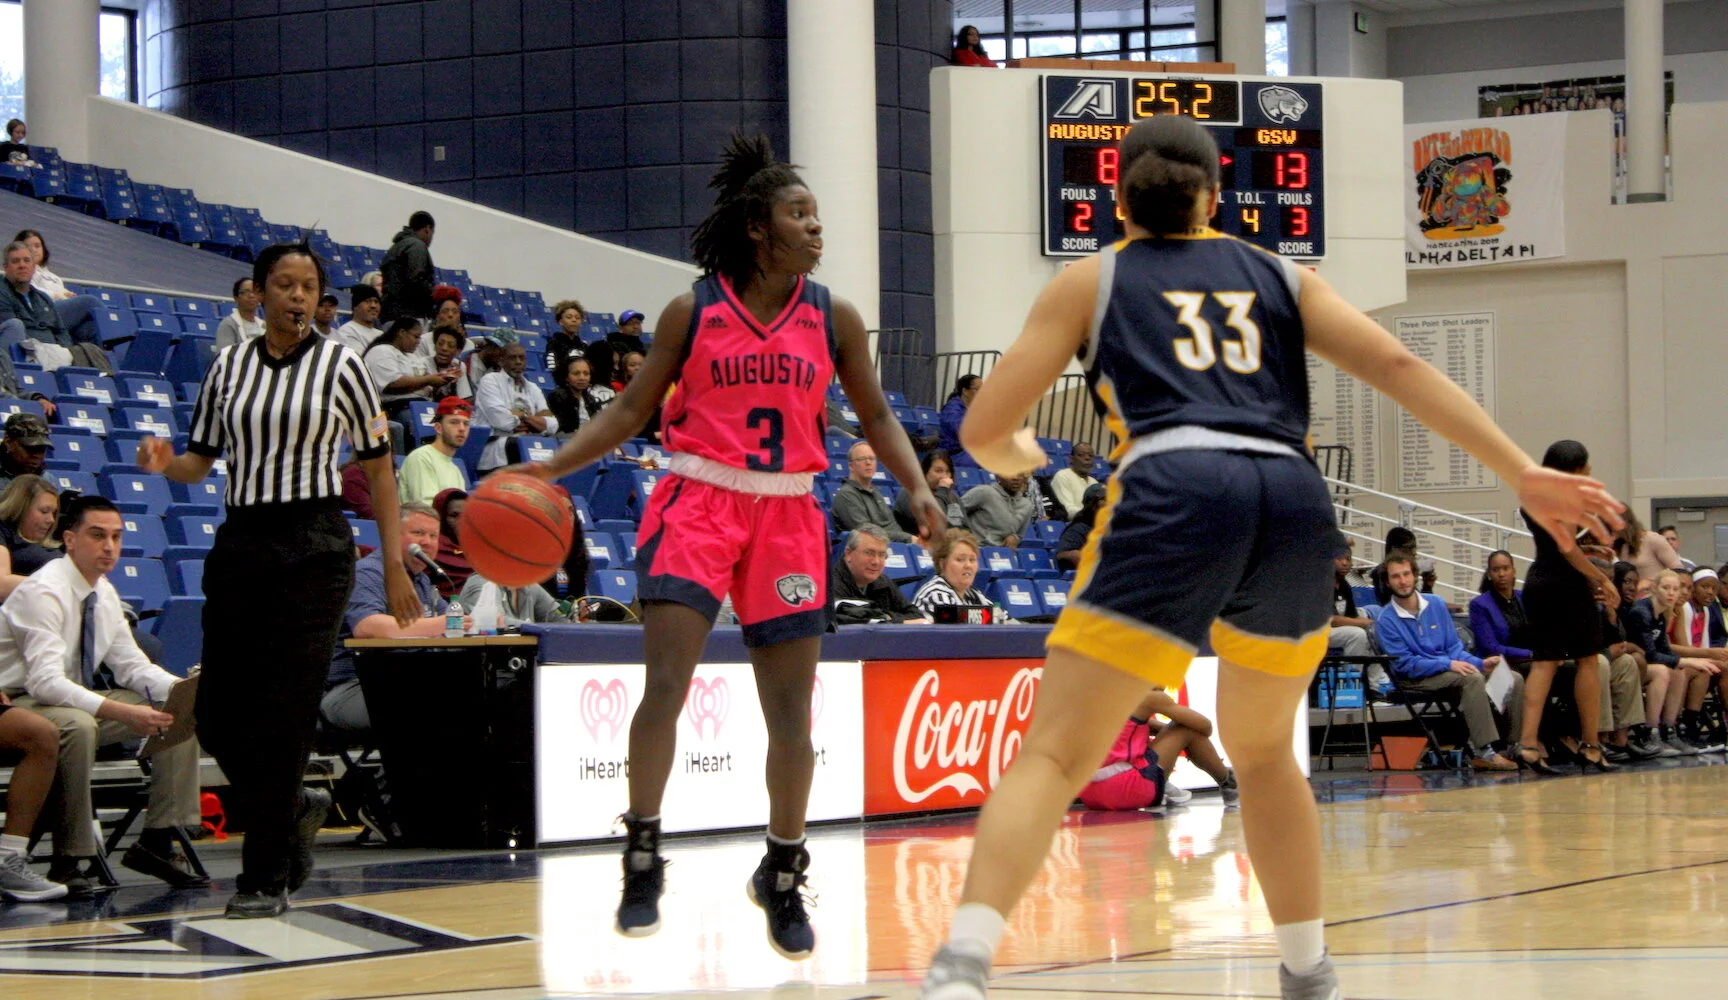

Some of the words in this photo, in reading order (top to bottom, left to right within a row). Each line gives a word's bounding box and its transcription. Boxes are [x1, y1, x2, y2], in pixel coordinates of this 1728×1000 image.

[1136, 81, 1212, 119] 25.2
[1049, 123, 1132, 141] AUGUST
[1257, 129, 1297, 145] GSW
[1274, 152, 1309, 189] 13
[1061, 188, 1097, 201] FOULS
[1235, 192, 1265, 205] T.O.L.
[1277, 193, 1313, 206] FOULS
[1073, 202, 1093, 232] 2
[1242, 208, 1260, 233] 4
[1291, 207, 1309, 236] 3
[1062, 237, 1099, 250] SCORE
[1278, 241, 1314, 254] SCORE
[1457, 245, 1514, 261] DELTA
[1520, 244, 1535, 257] PI
[1162, 290, 1262, 375] 33
[1421, 320, 1440, 328] Point
[711, 353, 817, 392] AUGUSTA
[746, 407, 784, 472] 3
[893, 667, 1045, 803] Coca-Co
[579, 757, 631, 781] iHeart
[685, 751, 732, 774] iHeart
